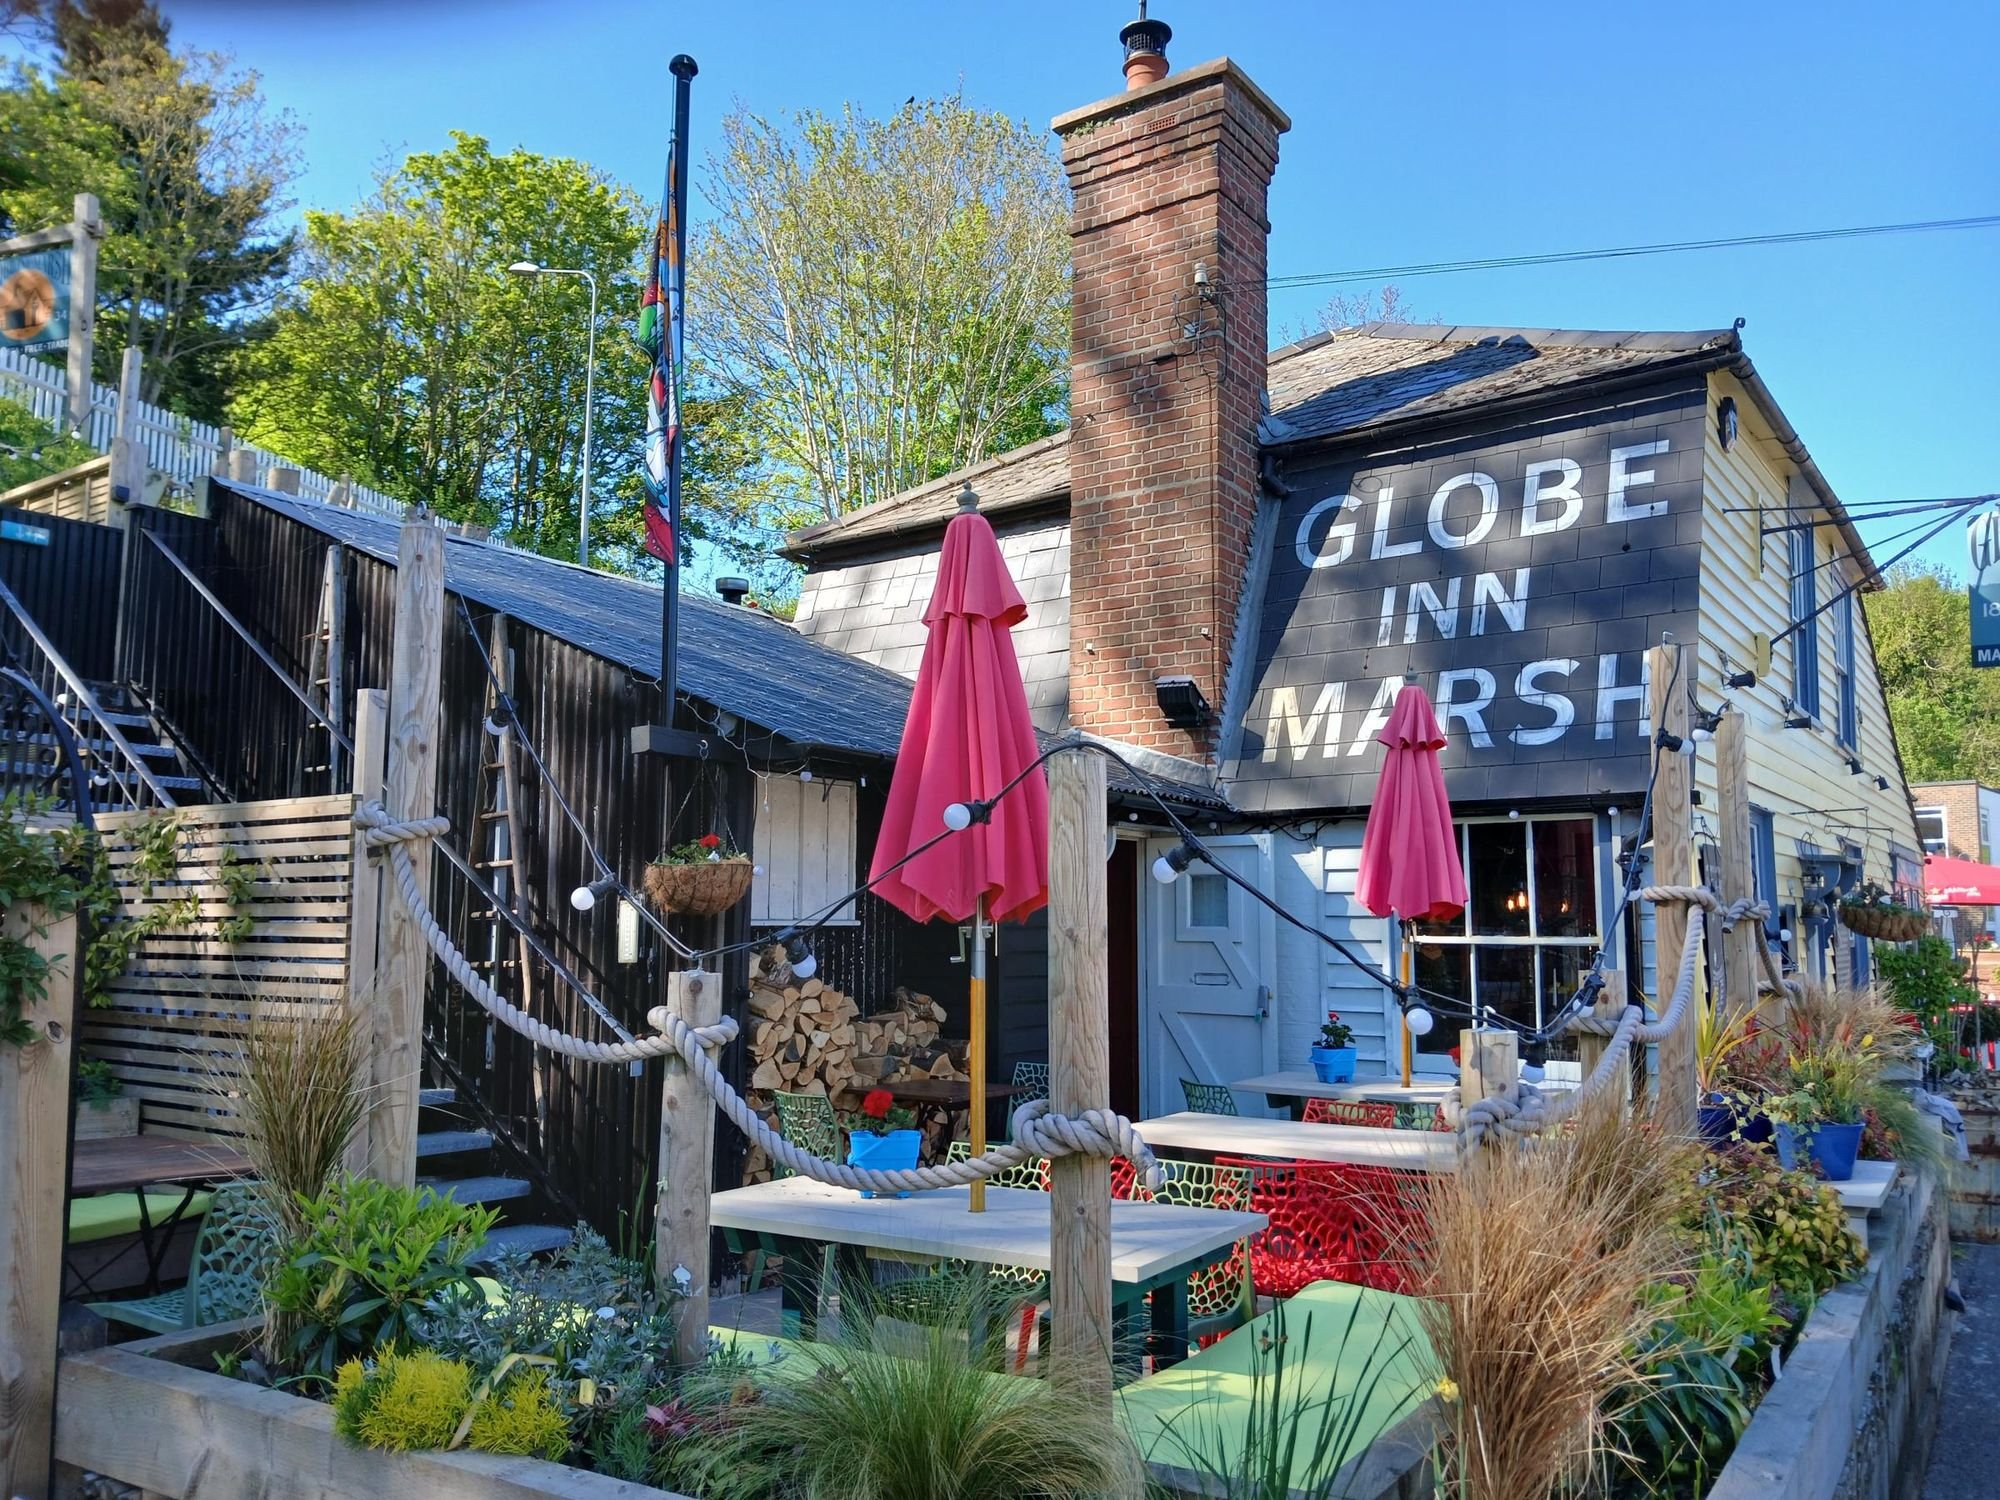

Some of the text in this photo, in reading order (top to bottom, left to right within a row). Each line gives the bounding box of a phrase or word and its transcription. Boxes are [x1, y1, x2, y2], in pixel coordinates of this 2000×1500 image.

[24, 344, 43, 353] FREE
[1295, 439, 1670, 569] GLOBE
[1376, 567, 1531, 647] INN
